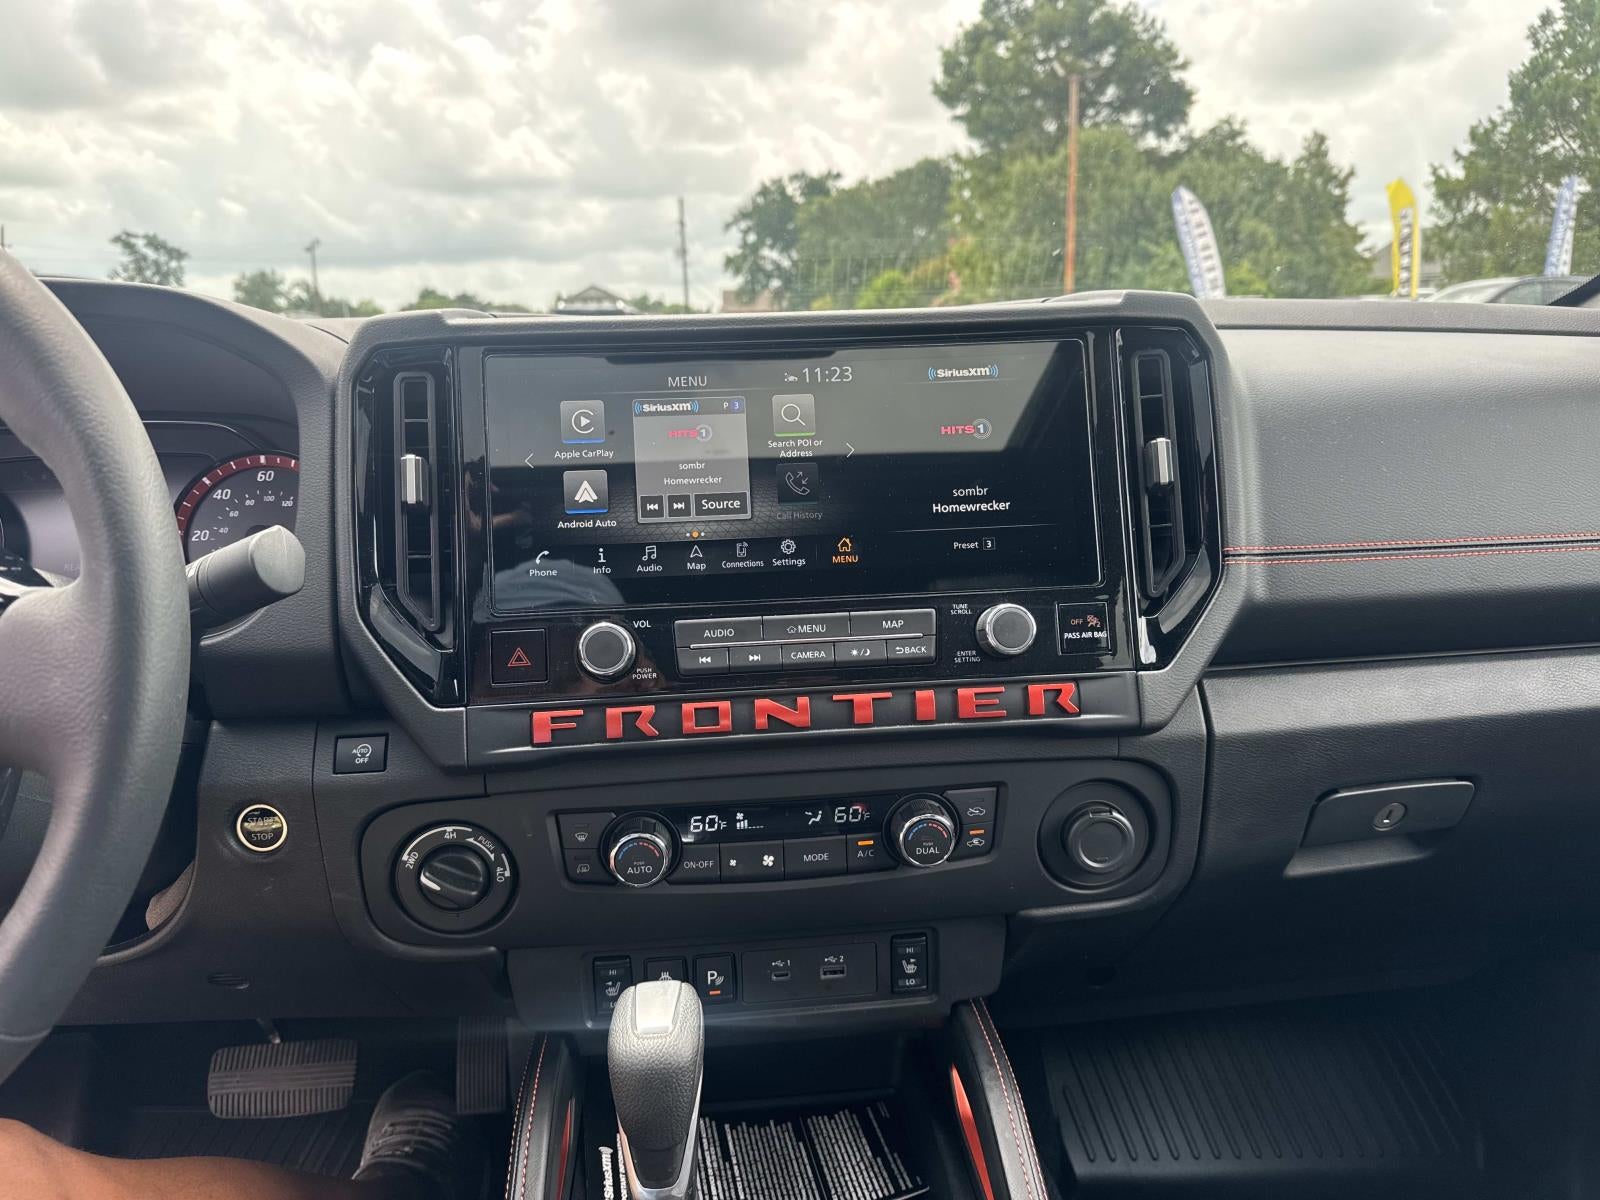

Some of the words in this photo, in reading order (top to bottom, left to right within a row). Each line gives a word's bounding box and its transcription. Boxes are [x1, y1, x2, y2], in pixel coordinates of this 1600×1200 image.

[802, 366, 853, 383] 11:23
[667, 376, 708, 388] MENU
[768, 440, 796, 448] Search
[797, 439, 812, 447] POI
[554, 450, 580, 460] Apple
[582, 449, 614, 459] CarPlay
[780, 449, 813, 458] Address
[678, 461, 706, 470] sombr
[256, 470, 274, 482] 60
[663, 476, 722, 486] Homewrecker
[212, 488, 231, 500] 40
[952, 486, 989, 497] sombr
[701, 500, 741, 510] Source
[932, 500, 1010, 514] Homewrecker
[776, 512, 792, 520] Call
[794, 511, 823, 520] History
[558, 520, 593, 529] Android
[192, 530, 210, 542] 20
[953, 541, 979, 550] Preset
[986, 540, 992, 548] 3
[722, 560, 764, 569] Connections
[772, 558, 806, 567] Settings
[832, 555, 859, 564] MENU
[593, 566, 612, 575] Info
[636, 564, 663, 573] Audio
[686, 562, 706, 572] Map
[529, 568, 558, 578] Phone
[632, 620, 652, 628] VOL
[882, 620, 904, 630] MAP
[703, 628, 735, 639] AUDIO
[798, 625, 827, 634] MENU
[790, 650, 826, 660] CAMERA
[904, 646, 928, 654] BACK
[532, 682, 1080, 745] FRONTIER
[251, 832, 274, 841] STOP
[444, 831, 458, 840] 4H
[478, 834, 496, 851] PUSH
[857, 850, 876, 858] A/C
[916, 846, 941, 855] DUAL
[404, 850, 420, 870] 2WD
[803, 852, 830, 862] MODE
[626, 865, 653, 874] AUTO
[683, 860, 715, 869] ON-OFF
[496, 866, 506, 883] 4LO
